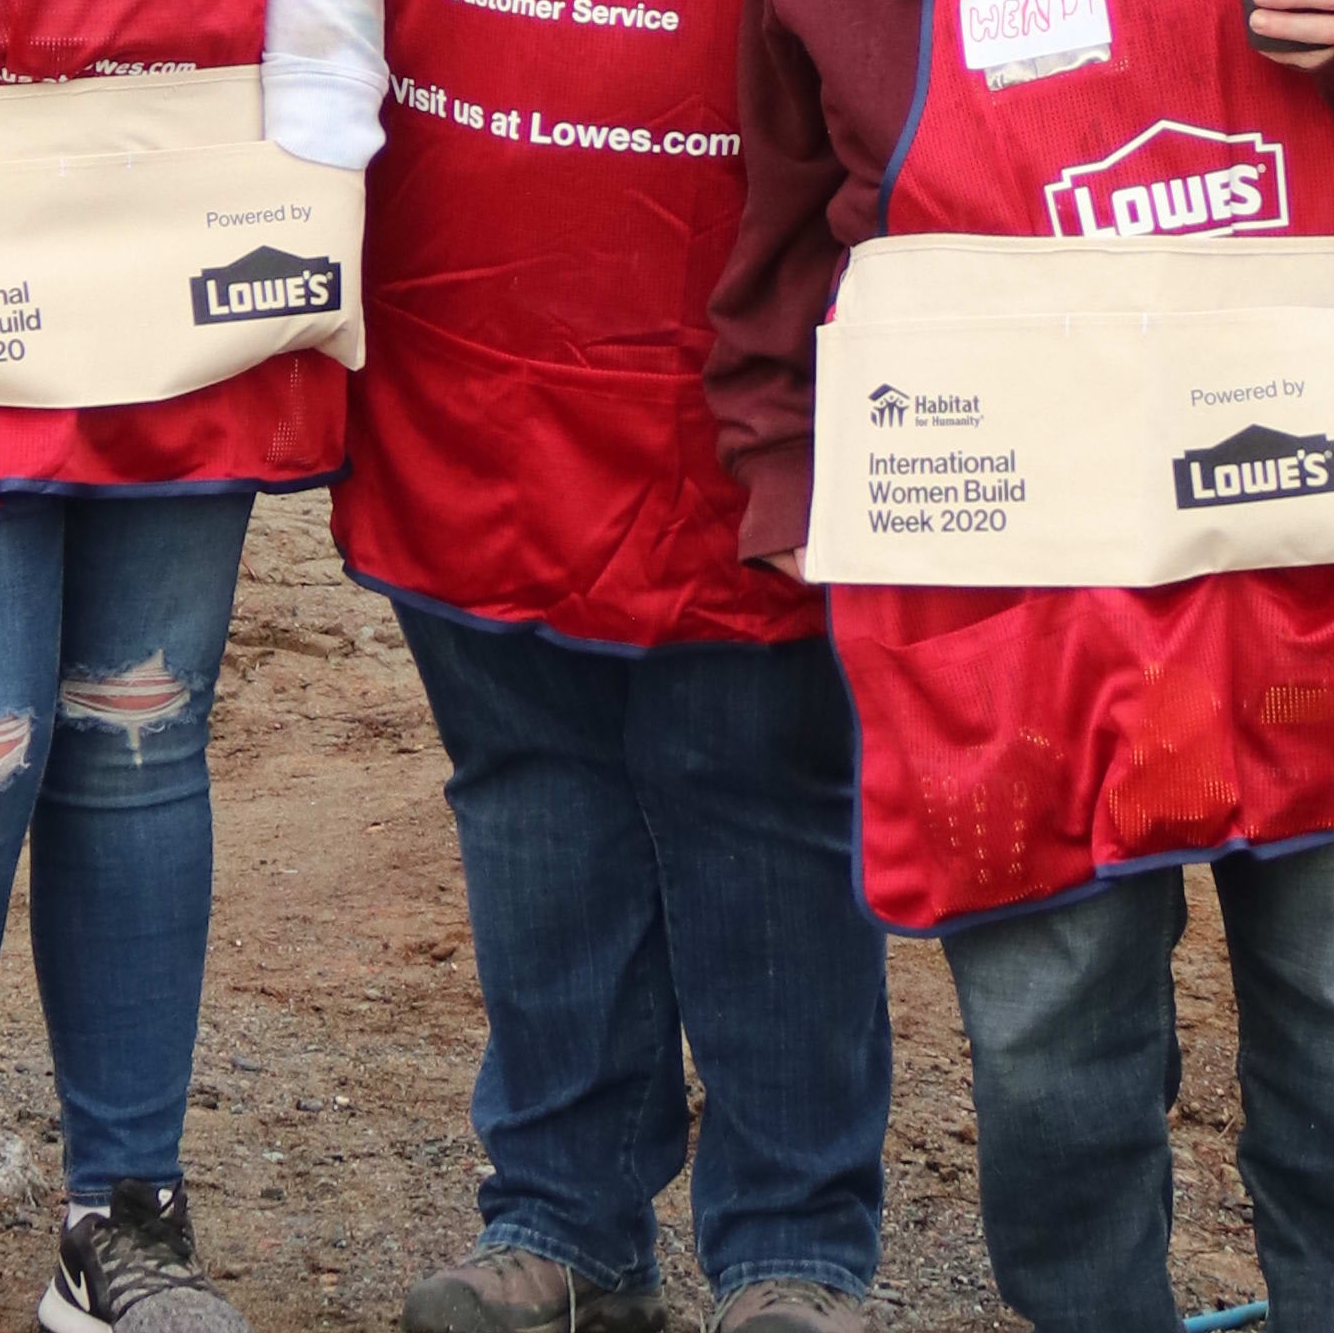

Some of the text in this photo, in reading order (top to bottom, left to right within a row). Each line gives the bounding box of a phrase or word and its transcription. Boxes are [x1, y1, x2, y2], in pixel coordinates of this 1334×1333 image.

[389, 74, 742, 157] Visit us at Lowes.com
[205, 203, 313, 228] Powered by
[206, 271, 331, 315] LOWE'S
[915, 395, 980, 414] Habitat
[1190, 378, 1306, 407] Powered by
[915, 415, 980, 428] for Humanity
[869, 449, 1016, 475] International
[1191, 449, 1330, 500] LOWE'S
[868, 478, 1026, 504] Women Build
[868, 508, 1007, 533] Week 2020
